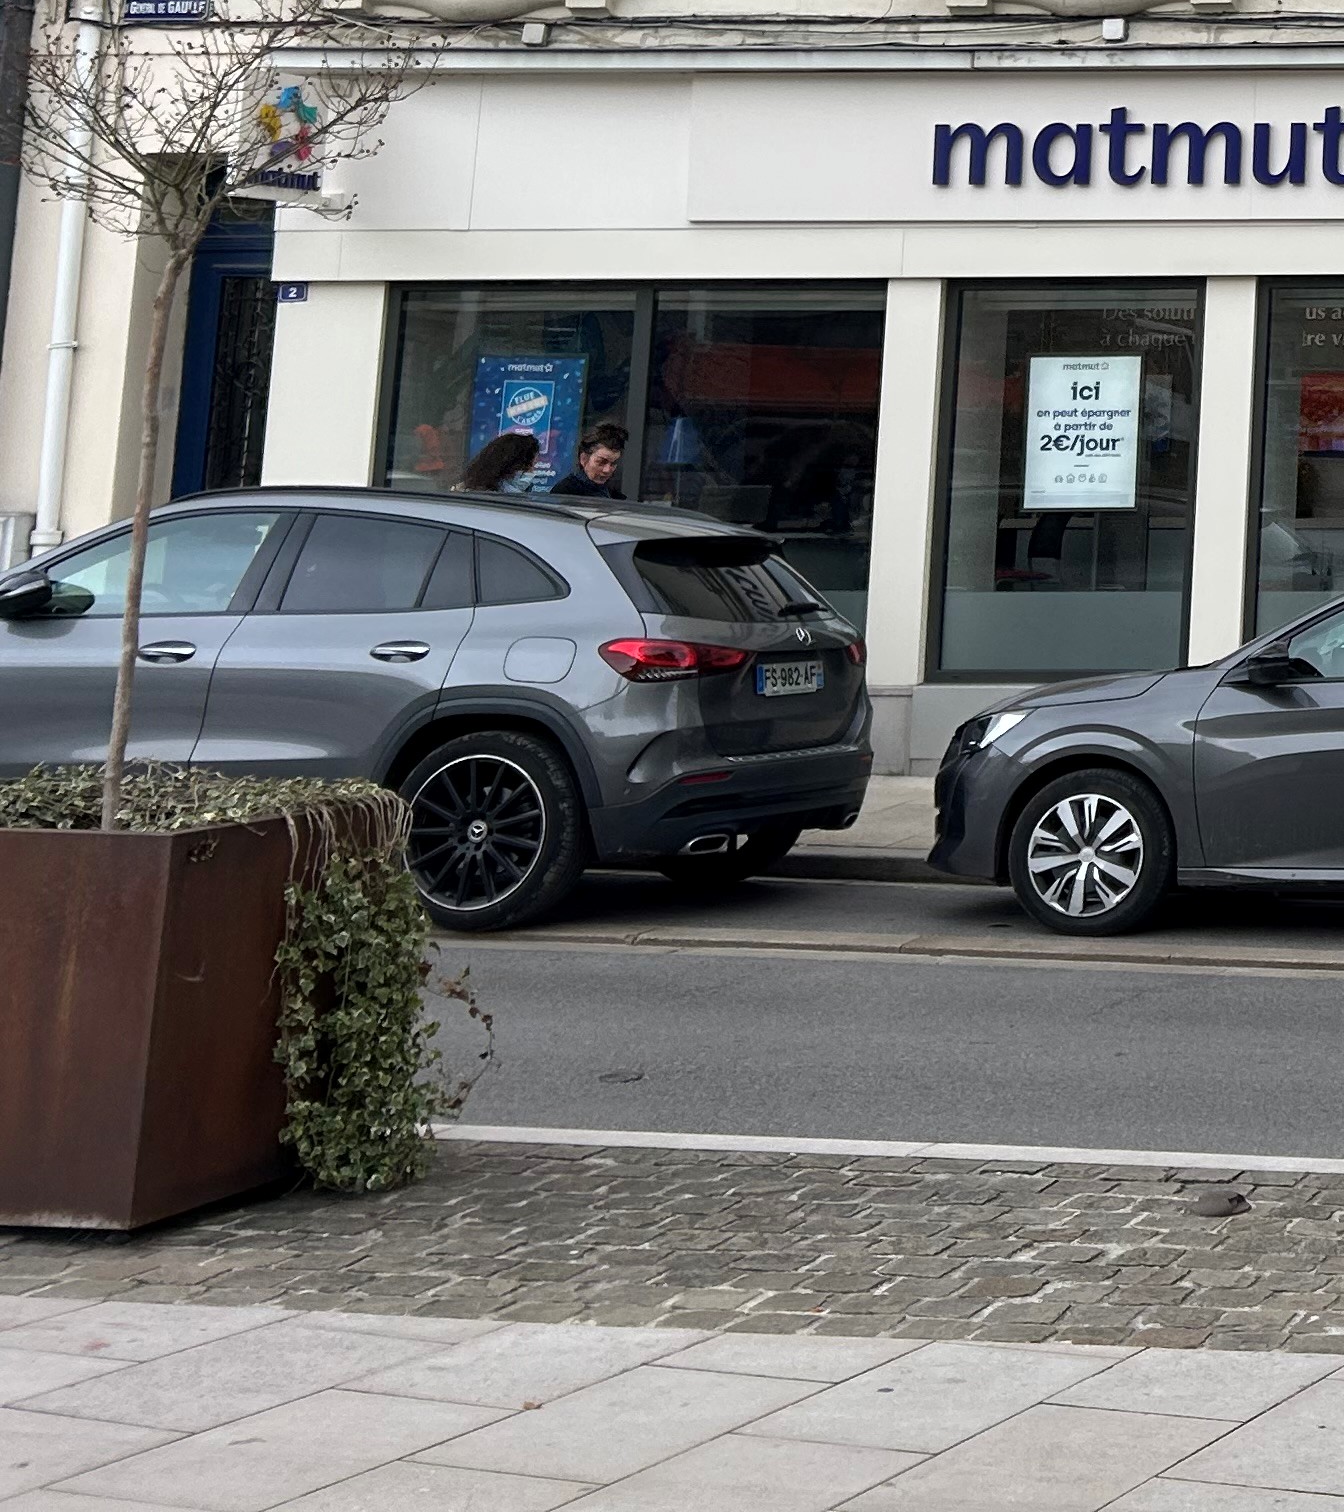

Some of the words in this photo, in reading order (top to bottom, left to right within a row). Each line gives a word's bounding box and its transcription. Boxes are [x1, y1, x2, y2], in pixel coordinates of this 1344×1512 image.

[157, 2, 167, 14] DE
[288, 287, 298, 298] 2
[1062, 363, 1100, 371] matmut
[1071, 381, 1101, 401] ici
[1036, 410, 1051, 418] on
[1053, 408, 1079, 420] peut
[1080, 408, 1132, 420] épargner
[1064, 422, 1097, 433] partir
[1098, 422, 1114, 431] de
[764, 663, 817, 688] FS-982-AF
